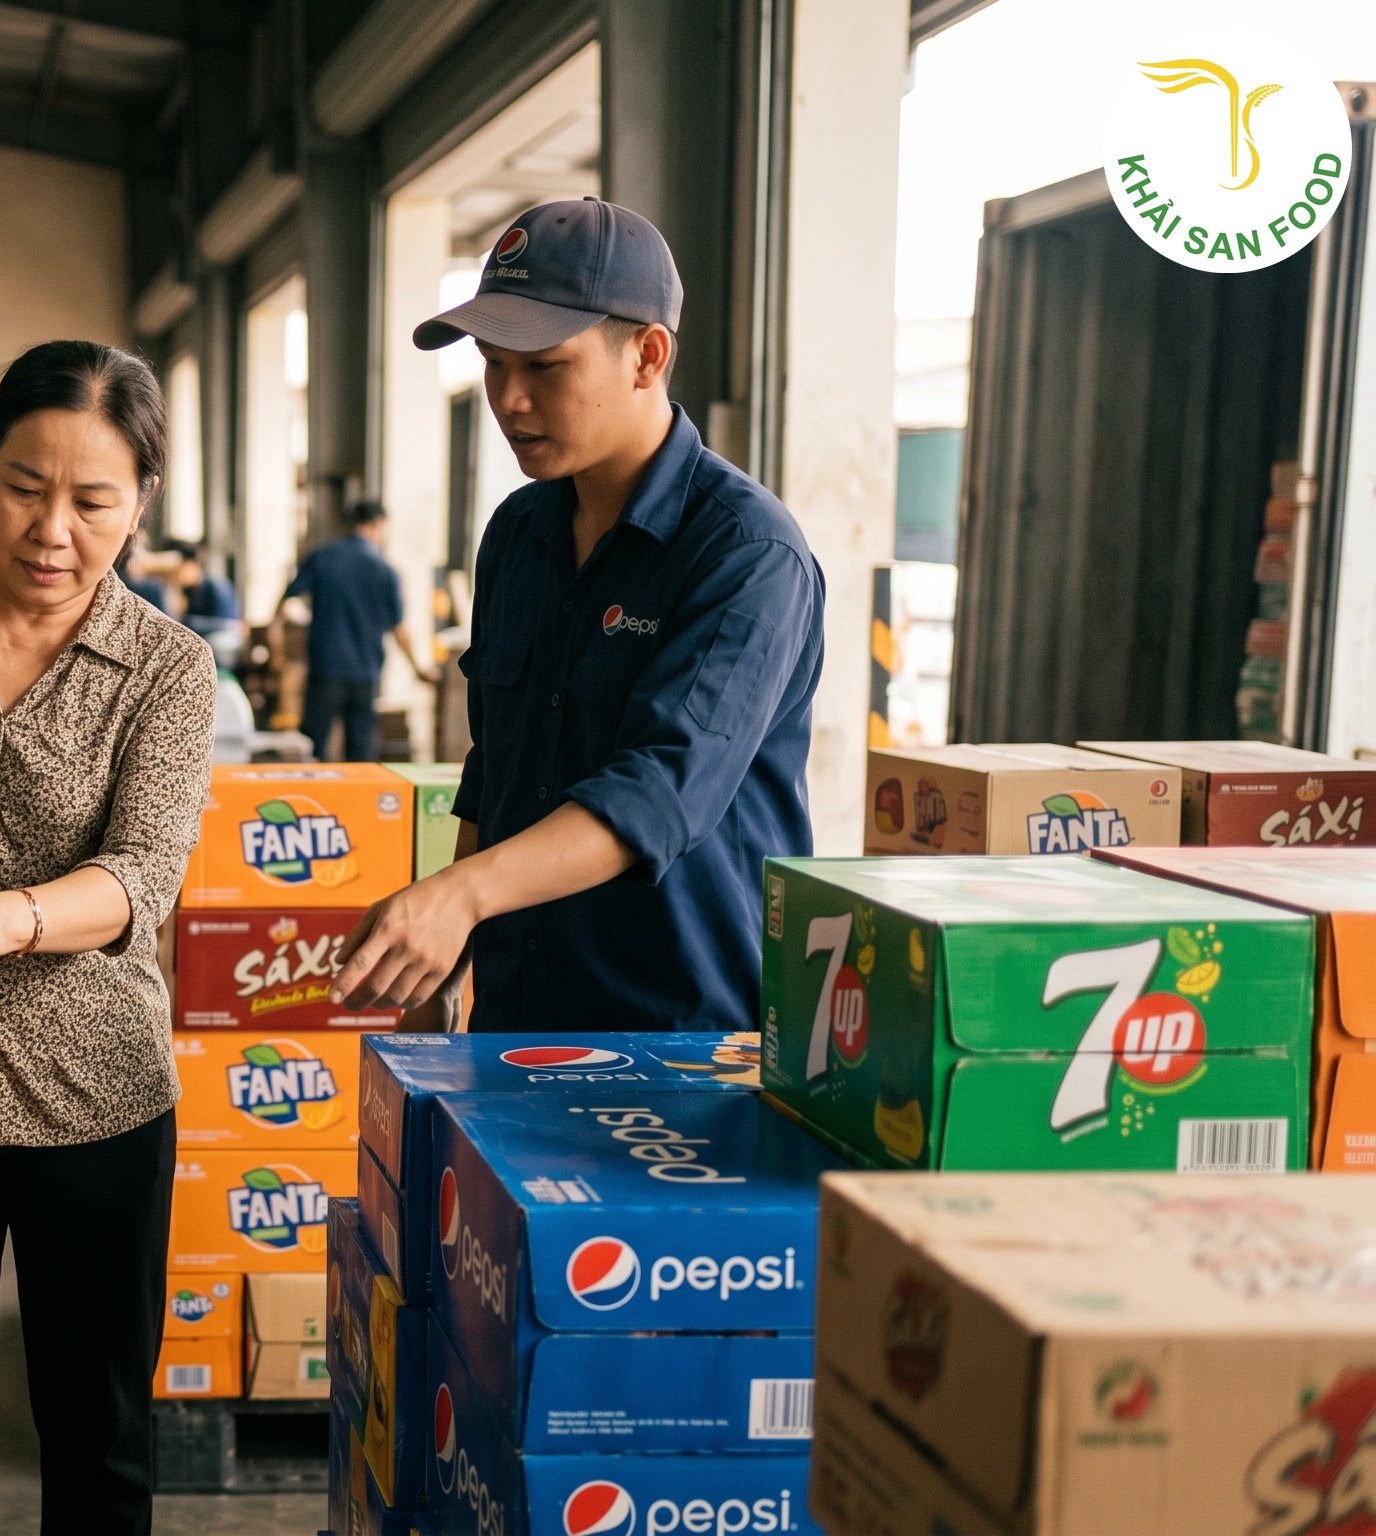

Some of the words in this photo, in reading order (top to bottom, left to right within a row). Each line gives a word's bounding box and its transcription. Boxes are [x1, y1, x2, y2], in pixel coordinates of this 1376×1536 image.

[240, 814, 352, 865] FANTA
[1027, 808, 1130, 854] FANTA
[805, 911, 854, 1082] 7
[1041, 937, 1165, 1133] 7
[227, 1058, 338, 1107] FANTA
[526, 1072, 650, 1083] pepsi
[568, 1107, 748, 1184] pepsi
[462, 1224, 508, 1325] pepsi
[650, 1247, 797, 1302] pepsi
[456, 1447, 506, 1536] pepsi
[646, 1488, 792, 1536] pepsi
